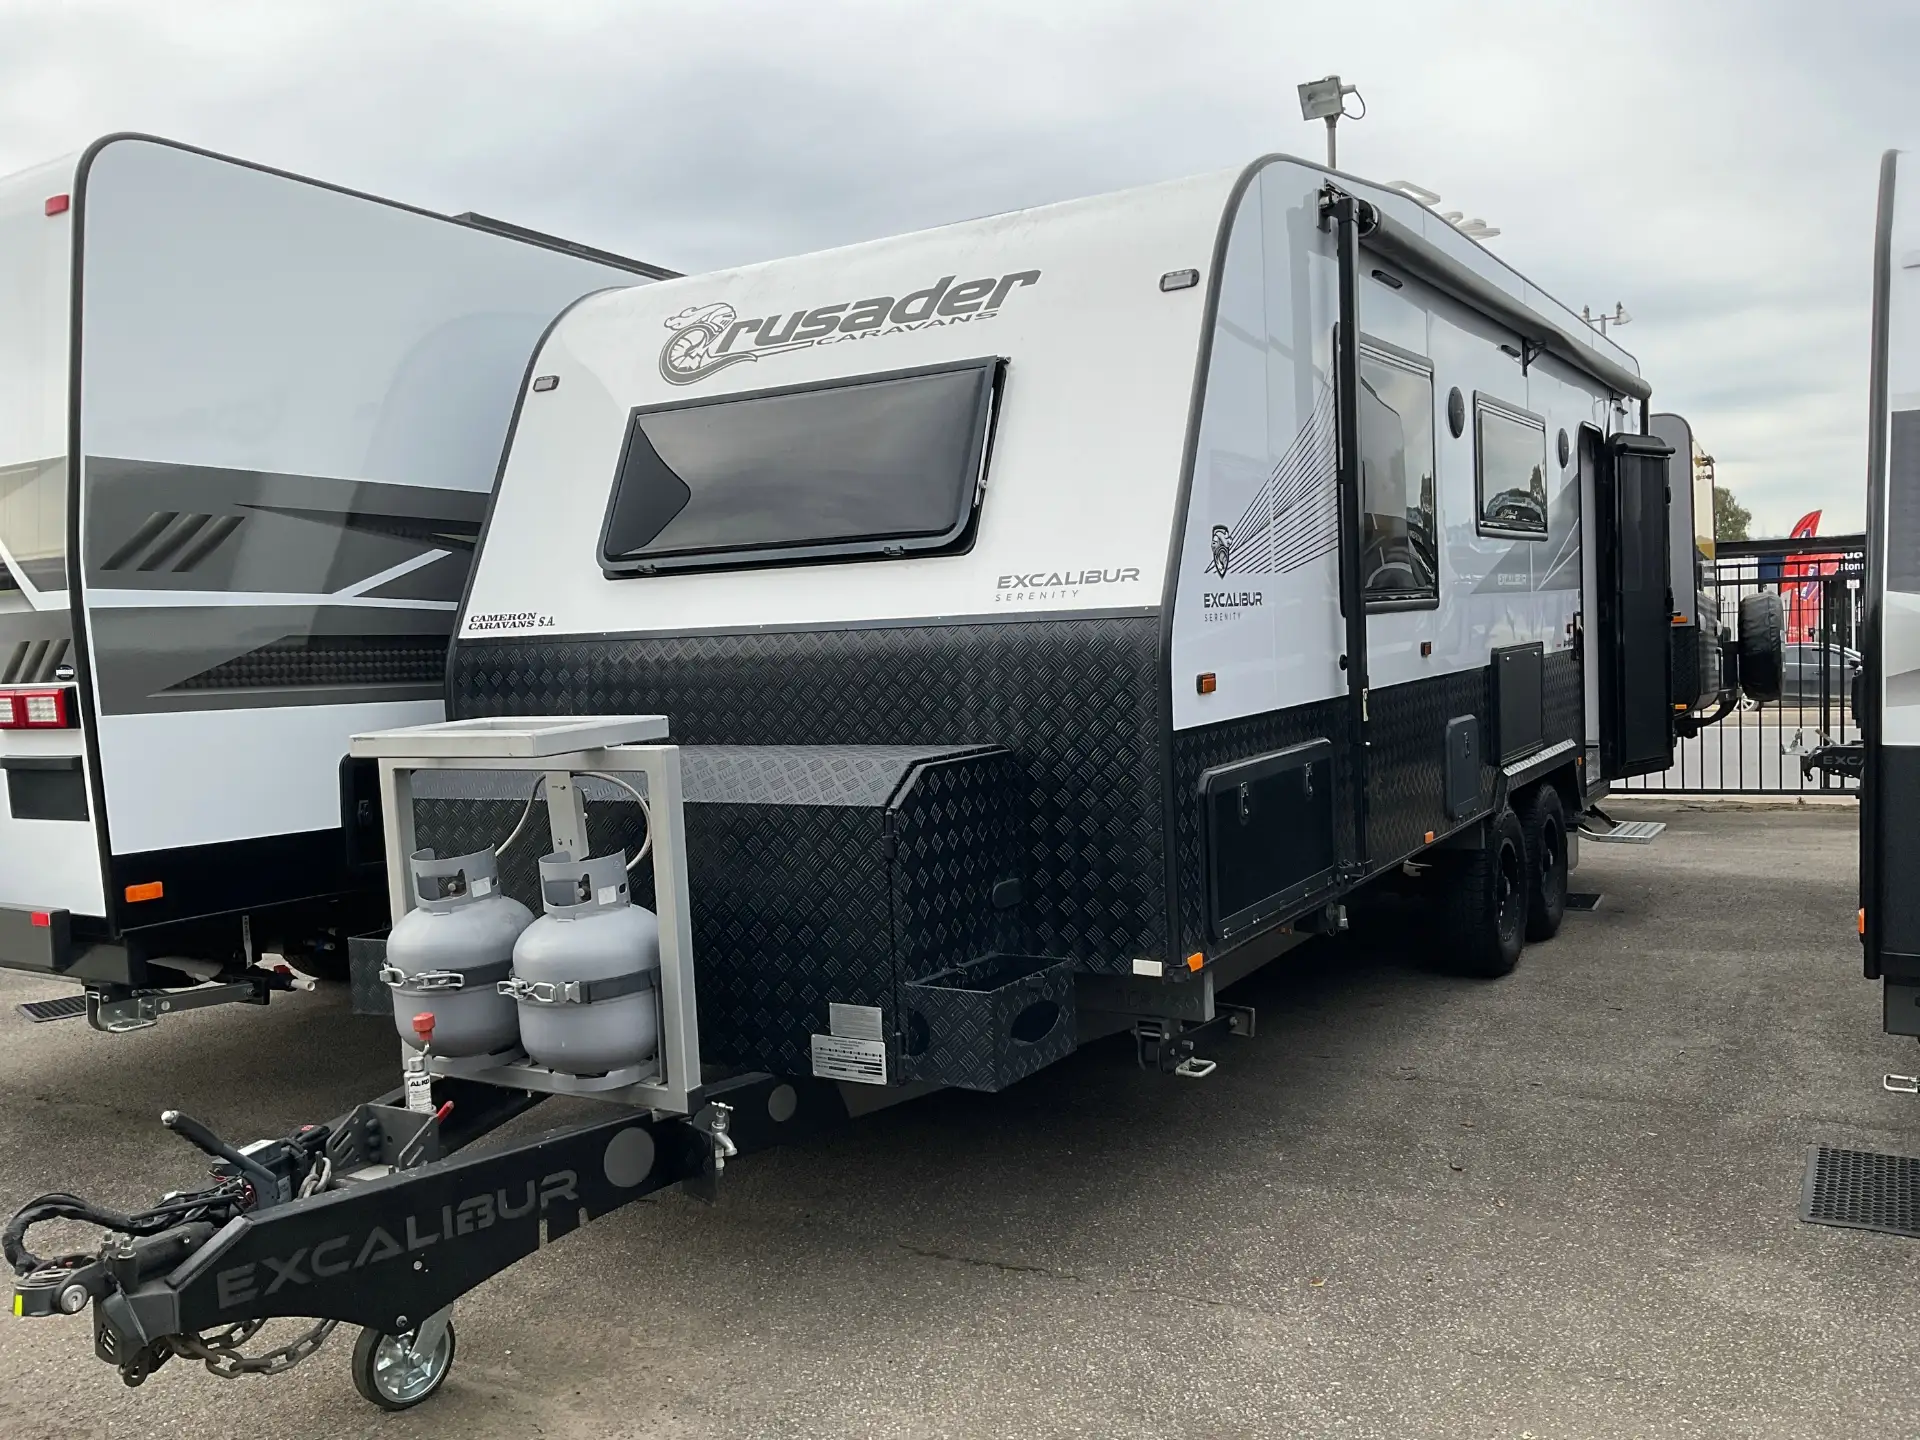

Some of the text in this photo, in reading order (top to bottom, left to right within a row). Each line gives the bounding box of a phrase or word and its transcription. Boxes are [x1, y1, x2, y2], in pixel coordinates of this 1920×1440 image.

[814, 309, 999, 346] CARAVANS
[996, 567, 1141, 590] EXCALIBUR
[994, 589, 1080, 602] SERENITY
[1203, 591, 1263, 609] EXCALIBUR
[468, 615, 556, 631] CARAVANS S.A.
[470, 612, 537, 623] CAMERON
[1204, 611, 1241, 623] SERENITY
[216, 1168, 580, 1310] EXCALIBUR
